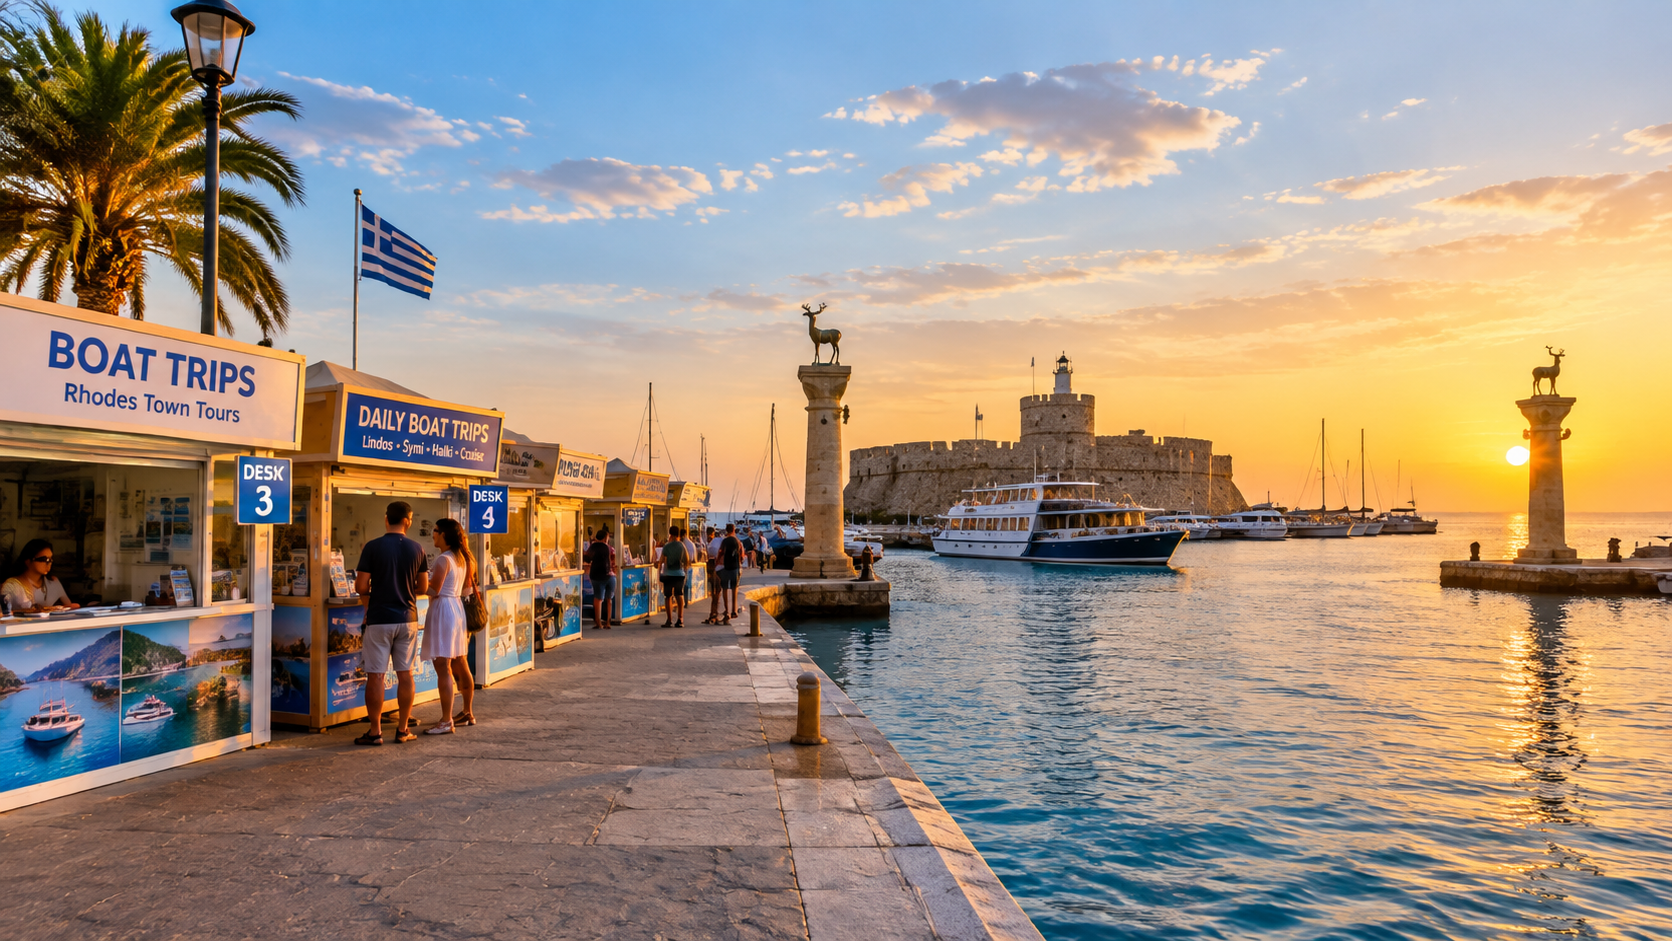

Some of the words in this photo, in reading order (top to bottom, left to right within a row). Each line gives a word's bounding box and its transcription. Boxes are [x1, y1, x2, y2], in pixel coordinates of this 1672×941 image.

[48, 330, 156, 382] BOAT
[166, 352, 256, 398] TRIPS
[64, 382, 137, 410] Rhodes
[144, 393, 190, 417] Town
[195, 401, 240, 423] Tours
[358, 405, 406, 432] DAILY
[408, 413, 449, 438] BOAT
[452, 420, 490, 443] TRIPS
[362, 435, 393, 451] Lindos
[402, 439, 424, 457] Symi
[243, 464, 285, 482] DESK
[254, 485, 273, 517] 3
[473, 490, 503, 503] DESK
